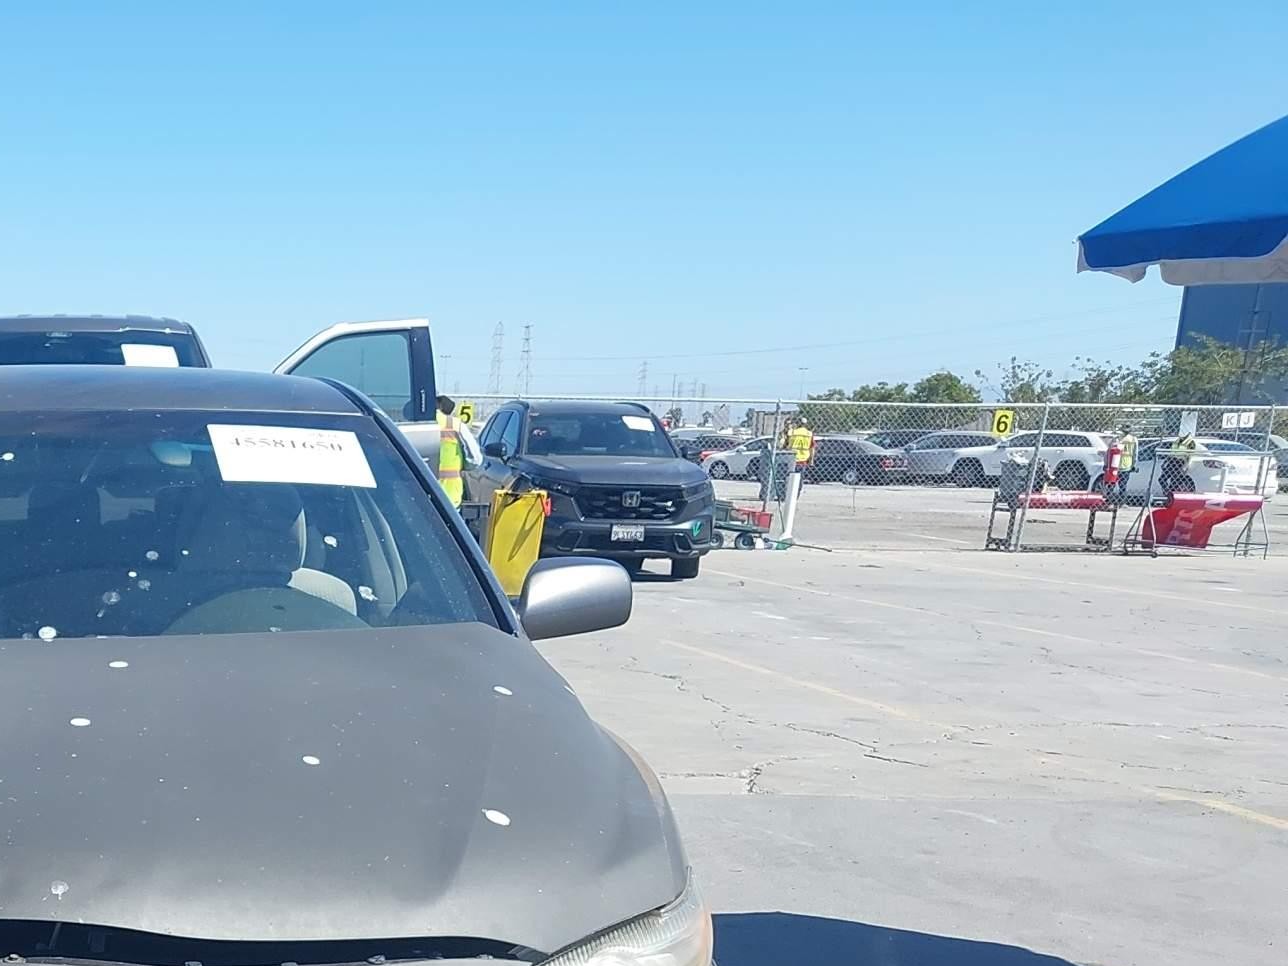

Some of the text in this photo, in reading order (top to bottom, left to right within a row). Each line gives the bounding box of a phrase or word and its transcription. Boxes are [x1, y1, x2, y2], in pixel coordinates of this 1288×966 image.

[460, 405, 471, 424] 5
[1226, 415, 1235, 426] K
[1243, 415, 1251, 425] J
[996, 414, 1009, 433] 6
